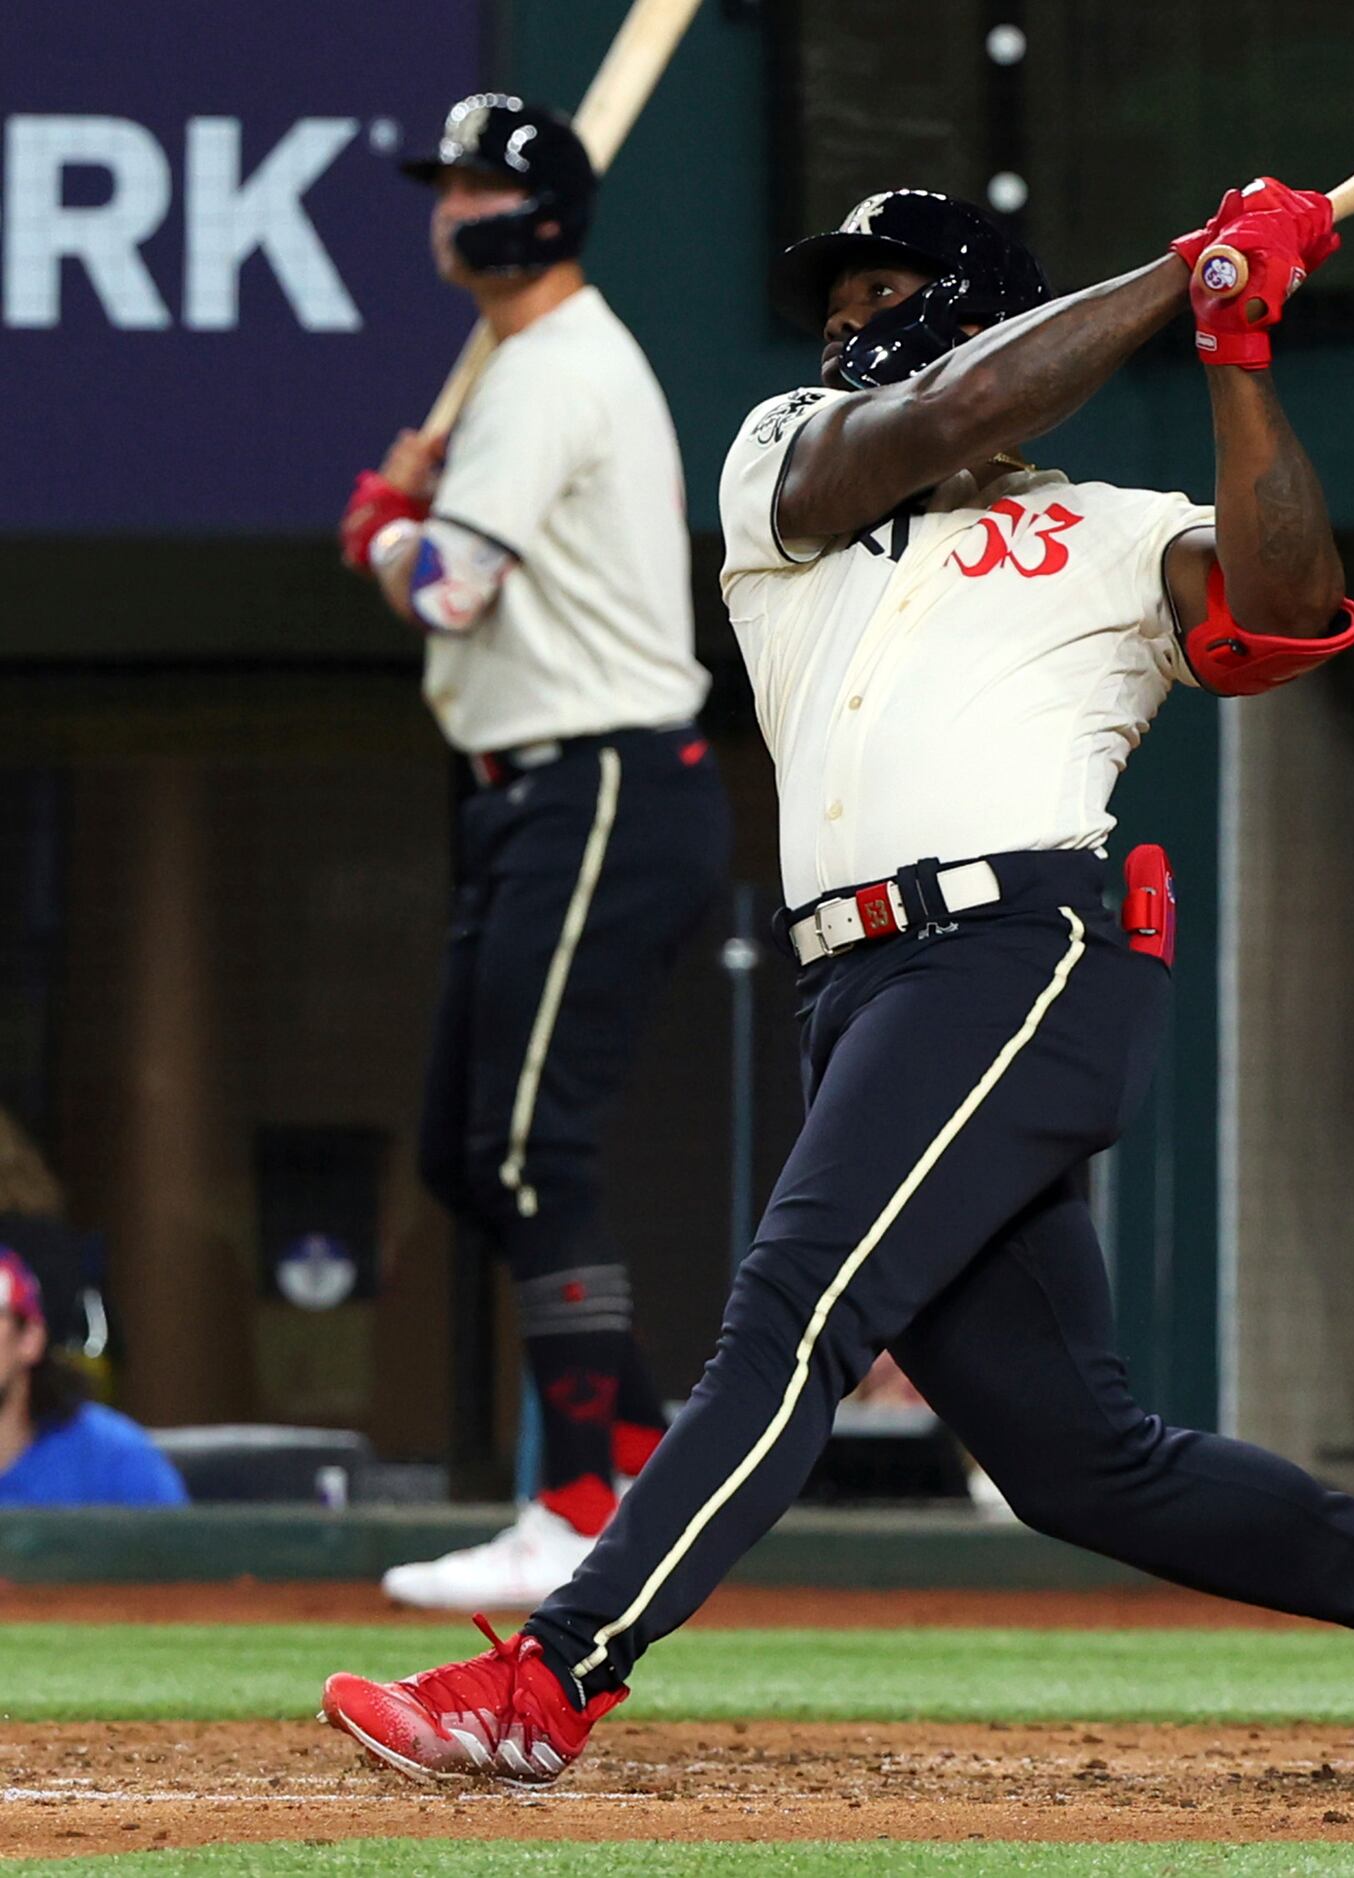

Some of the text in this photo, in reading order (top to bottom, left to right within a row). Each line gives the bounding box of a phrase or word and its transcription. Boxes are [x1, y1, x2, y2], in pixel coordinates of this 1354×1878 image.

[4, 113, 364, 333] RK
[943, 496, 1085, 578] 53
[865, 899, 889, 929] 53
